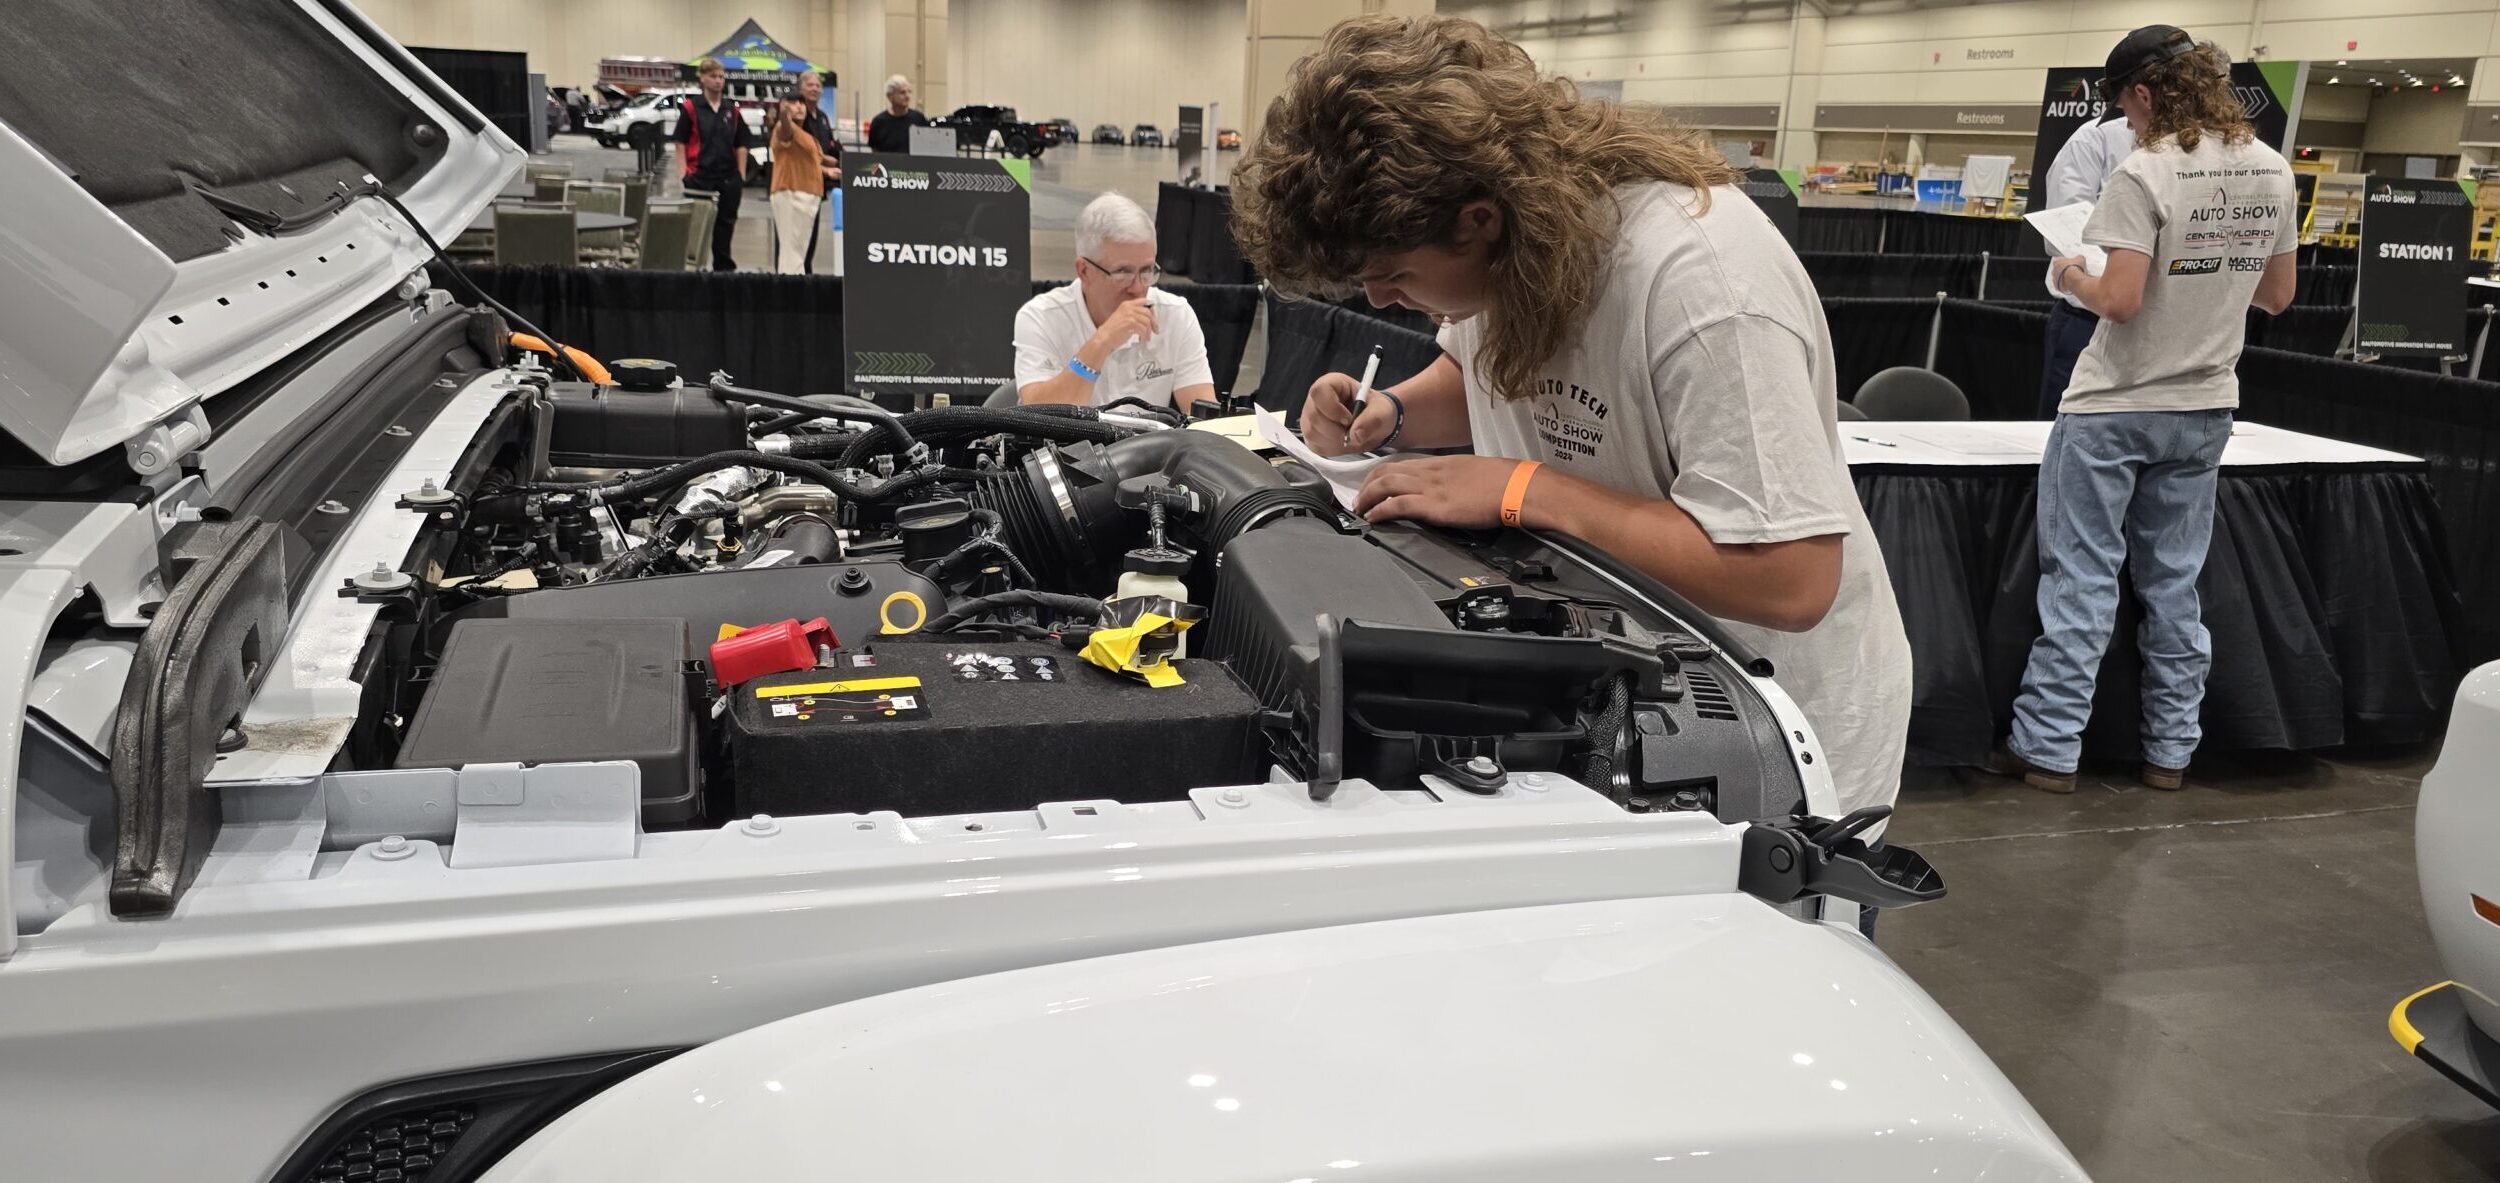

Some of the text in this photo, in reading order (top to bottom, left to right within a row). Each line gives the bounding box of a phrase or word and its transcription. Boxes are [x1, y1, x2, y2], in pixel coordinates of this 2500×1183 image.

[1967, 49, 2014, 60] Restrooms
[2046, 101, 2088, 118] AUTO
[1957, 112, 2005, 124] Restrooms
[2176, 169, 2205, 180] Thank
[2208, 170, 2221, 178] you
[2224, 169, 2233, 177] to
[2234, 169, 2249, 177] our
[853, 176, 930, 190] AUTO SHOW
[2370, 193, 2392, 203] AUTO
[2393, 195, 2416, 204] SHOW
[2189, 206, 2279, 222] AUTO SHOW
[2185, 229, 2275, 241] CENTRAL FLORIDA
[868, 242, 1008, 267] STATION 15
[2379, 243, 2454, 261] STATION 1
[854, 374, 911, 384] #AUTOMOTIVE
[913, 375, 962, 385] INNOVATION
[963, 376, 983, 385] THAT
[1538, 379, 1564, 396] UTO
[1570, 384, 1608, 420] TECH
[1533, 411, 1559, 432] AUTO
[1562, 423, 1603, 444] SHOW
[1538, 428, 1596, 457] COMPETITION
